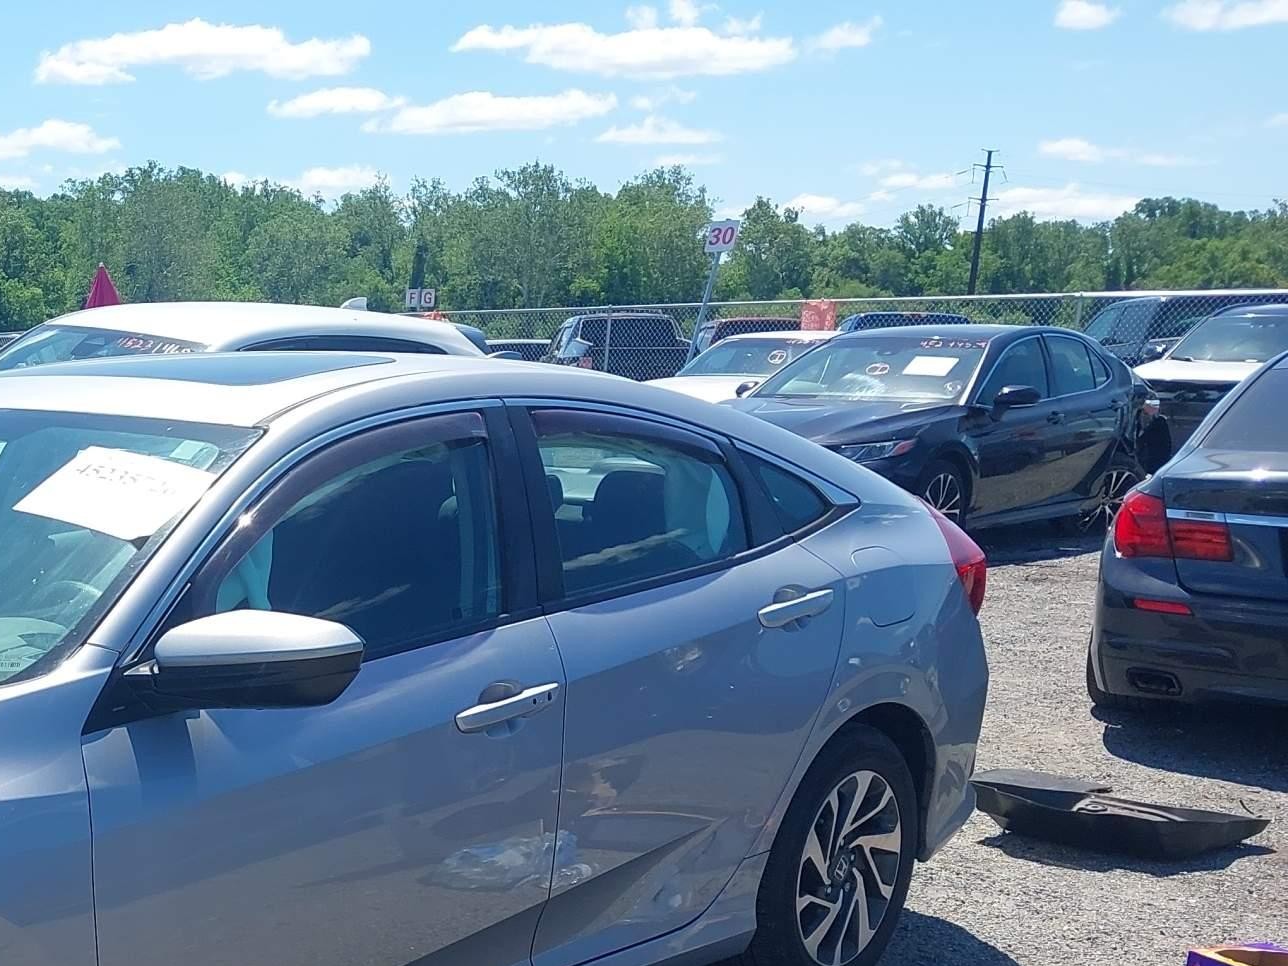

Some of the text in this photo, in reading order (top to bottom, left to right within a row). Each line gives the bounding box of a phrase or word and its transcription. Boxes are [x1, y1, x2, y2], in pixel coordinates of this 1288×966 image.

[708, 226, 735, 246] 30
[409, 291, 432, 304] F G
